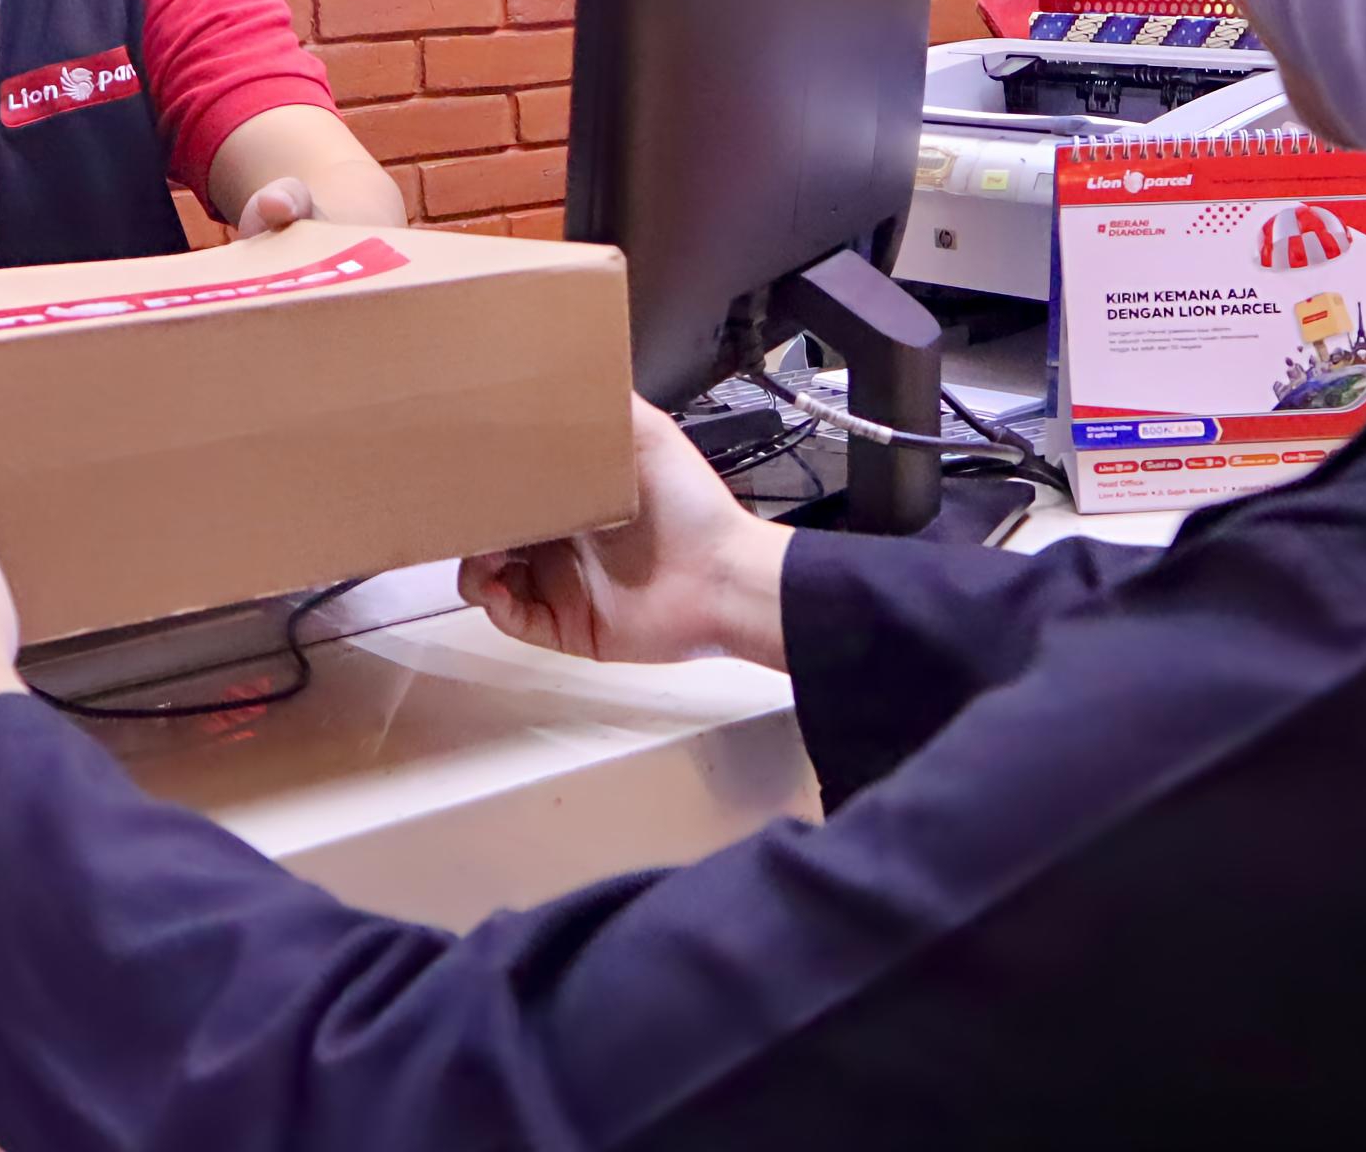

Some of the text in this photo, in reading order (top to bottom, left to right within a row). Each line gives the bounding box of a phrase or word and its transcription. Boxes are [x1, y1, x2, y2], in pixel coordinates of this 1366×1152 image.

[8, 84, 58, 110] Lion
[1087, 173, 1194, 190] Lion parcel
[1106, 288, 1258, 304] KIRIM KEMANA AJA
[1107, 303, 1282, 320] DENGAN LION PARCEL
